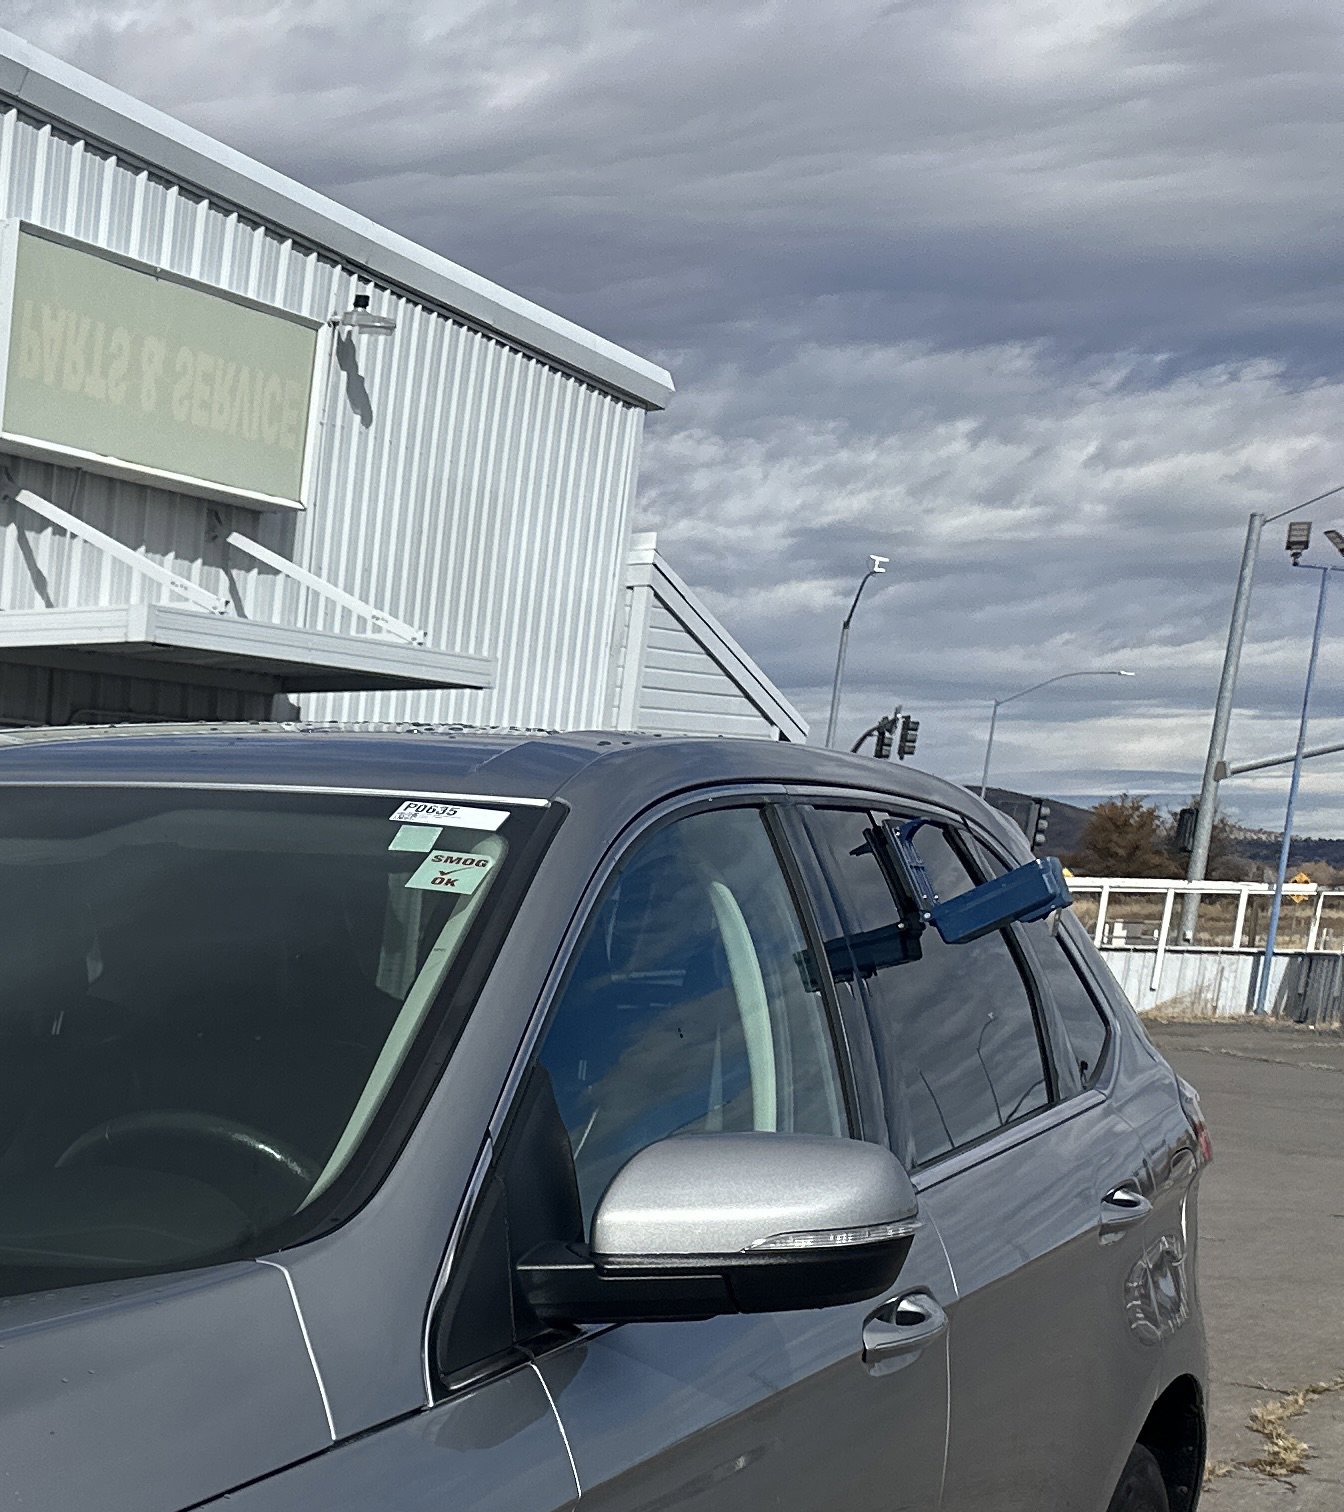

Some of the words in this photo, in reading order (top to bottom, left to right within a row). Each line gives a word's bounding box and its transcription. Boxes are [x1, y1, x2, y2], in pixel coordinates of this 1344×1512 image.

[403, 802, 460, 816] P0635
[431, 855, 488, 867] SMOG
[430, 877, 460, 887] OK
